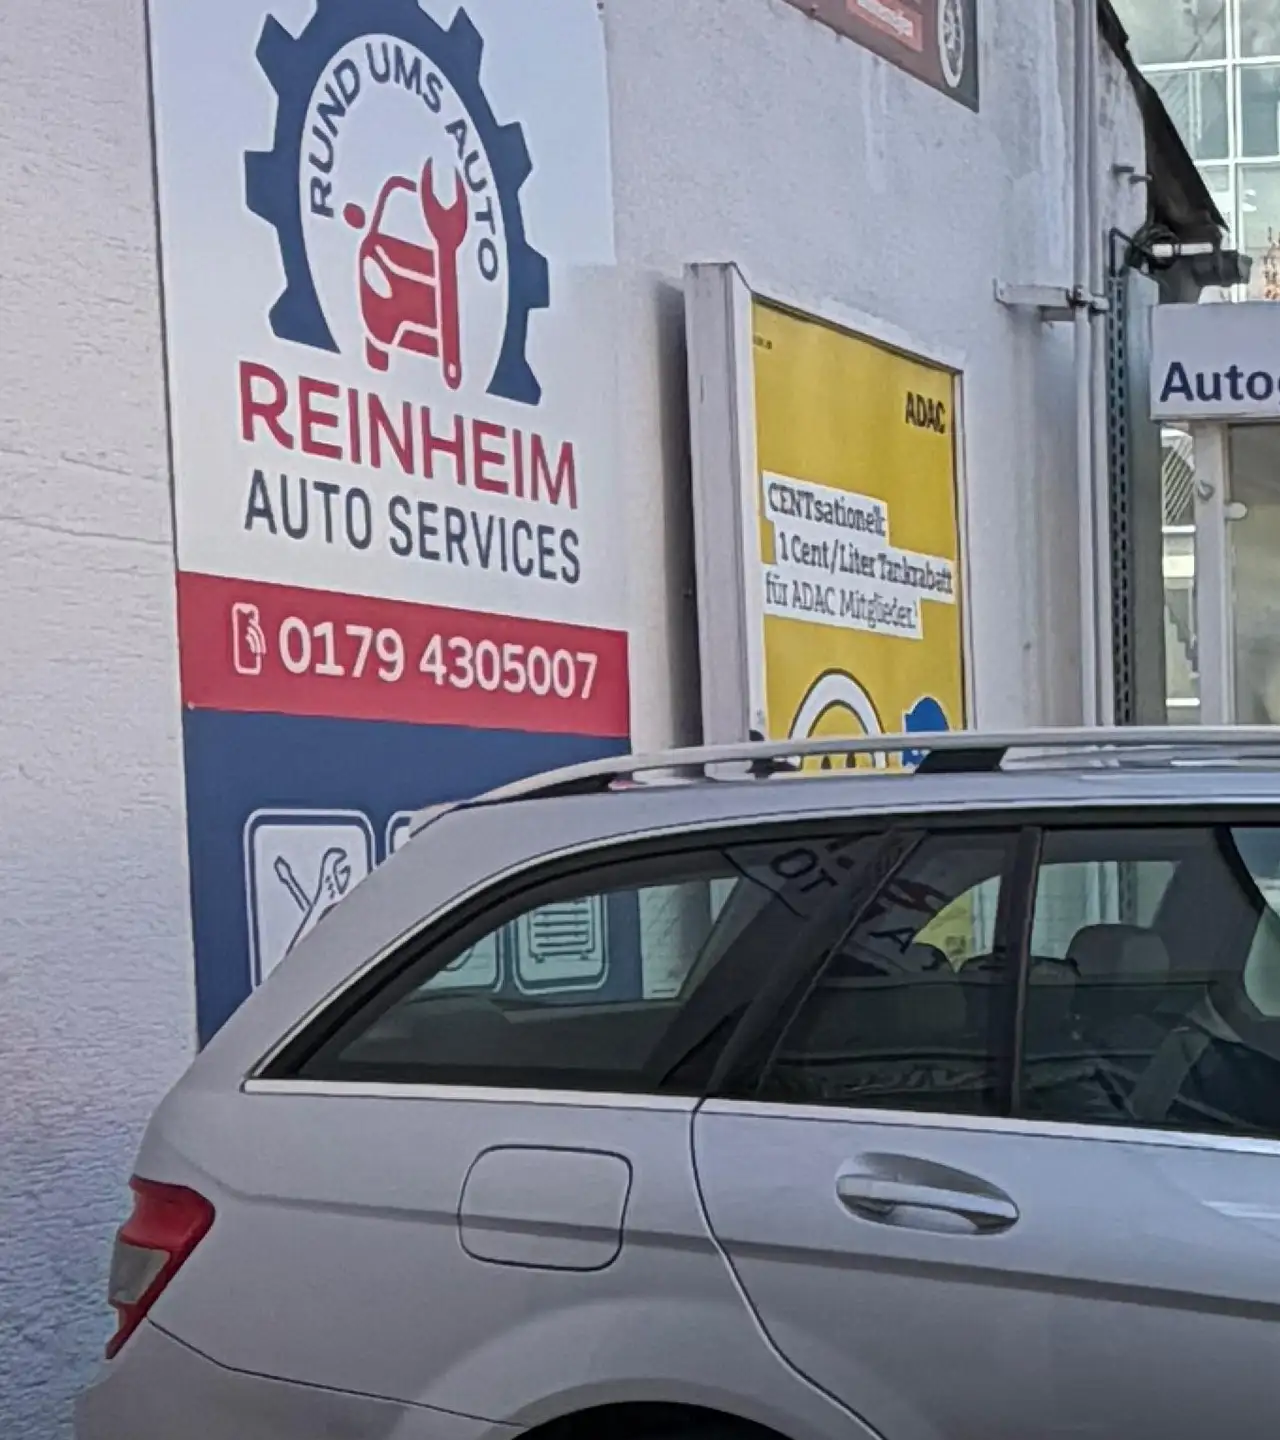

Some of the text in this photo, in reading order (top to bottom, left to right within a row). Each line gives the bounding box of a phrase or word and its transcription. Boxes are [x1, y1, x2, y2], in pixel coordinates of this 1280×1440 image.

[308, 41, 499, 283] RUND UMS AUTO
[239, 360, 579, 510] REINHEIM
[904, 391, 947, 434] ADAC
[243, 469, 581, 585] AUTO SERVICES
[779, 531, 788, 561] 1
[765, 571, 788, 607] für
[791, 580, 836, 617] ADAC
[278, 616, 599, 700] 0179 4305007
